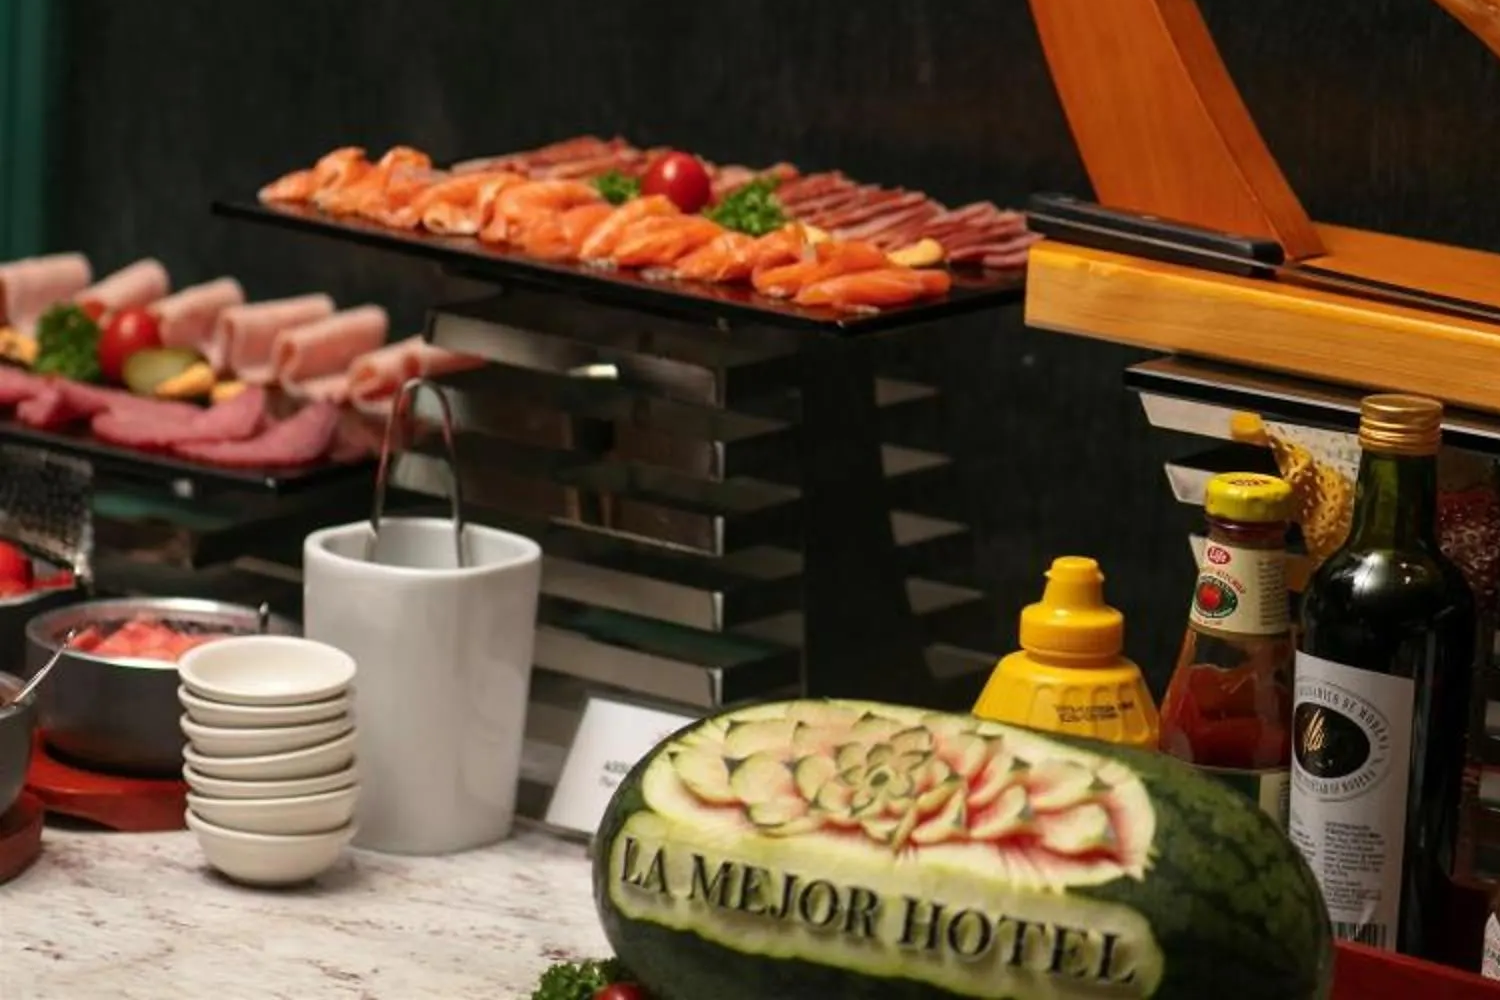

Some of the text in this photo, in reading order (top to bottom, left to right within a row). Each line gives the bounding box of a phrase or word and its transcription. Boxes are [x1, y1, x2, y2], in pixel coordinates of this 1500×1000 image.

[620, 836, 1137, 984] LA MEJOR HOTEL
